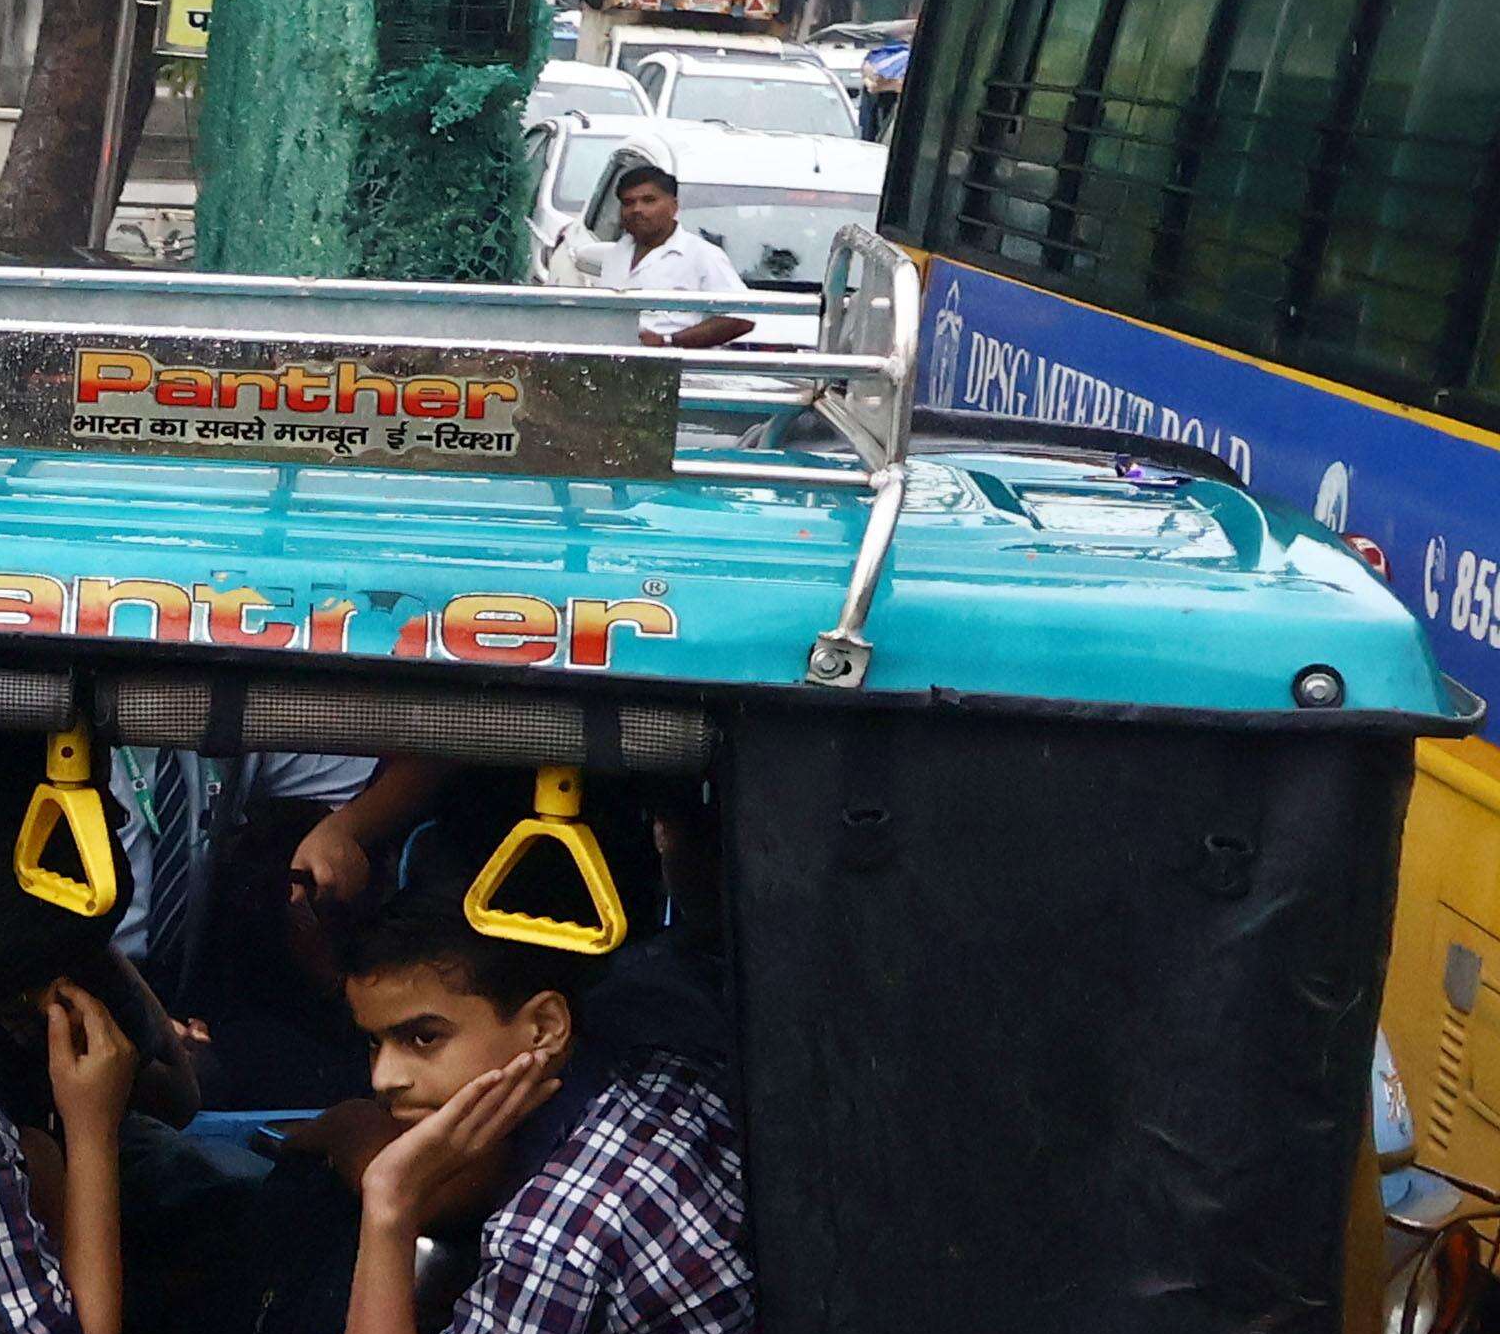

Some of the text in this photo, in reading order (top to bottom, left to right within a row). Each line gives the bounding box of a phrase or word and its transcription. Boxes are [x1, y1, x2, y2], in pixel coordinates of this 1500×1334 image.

[77, 351, 518, 420] Panther
[964, 331, 1031, 416] DPSG
[73, 414, 142, 437] भारत
[150, 416, 187, 438] का
[195, 416, 266, 442] सबसे
[273, 424, 369, 455] मजबूत
[386, 421, 408, 452] ई
